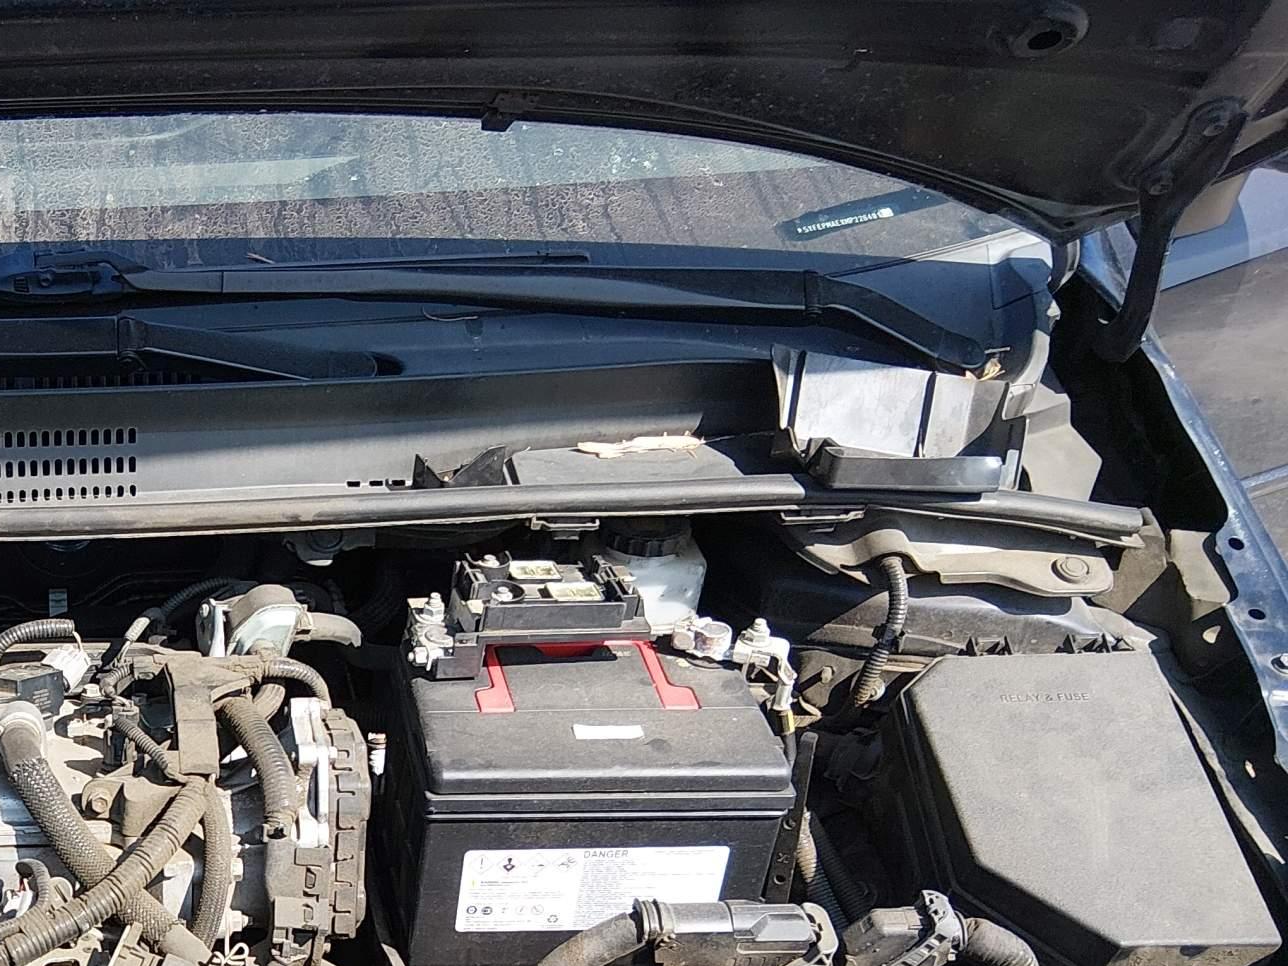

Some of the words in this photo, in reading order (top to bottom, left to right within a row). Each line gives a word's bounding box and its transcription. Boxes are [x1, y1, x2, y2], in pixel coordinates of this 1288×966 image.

[999, 693, 1041, 703] RELAY
[1044, 693, 1054, 702] &
[1056, 692, 1090, 702] FUSE
[583, 850, 629, 859] DANGER
